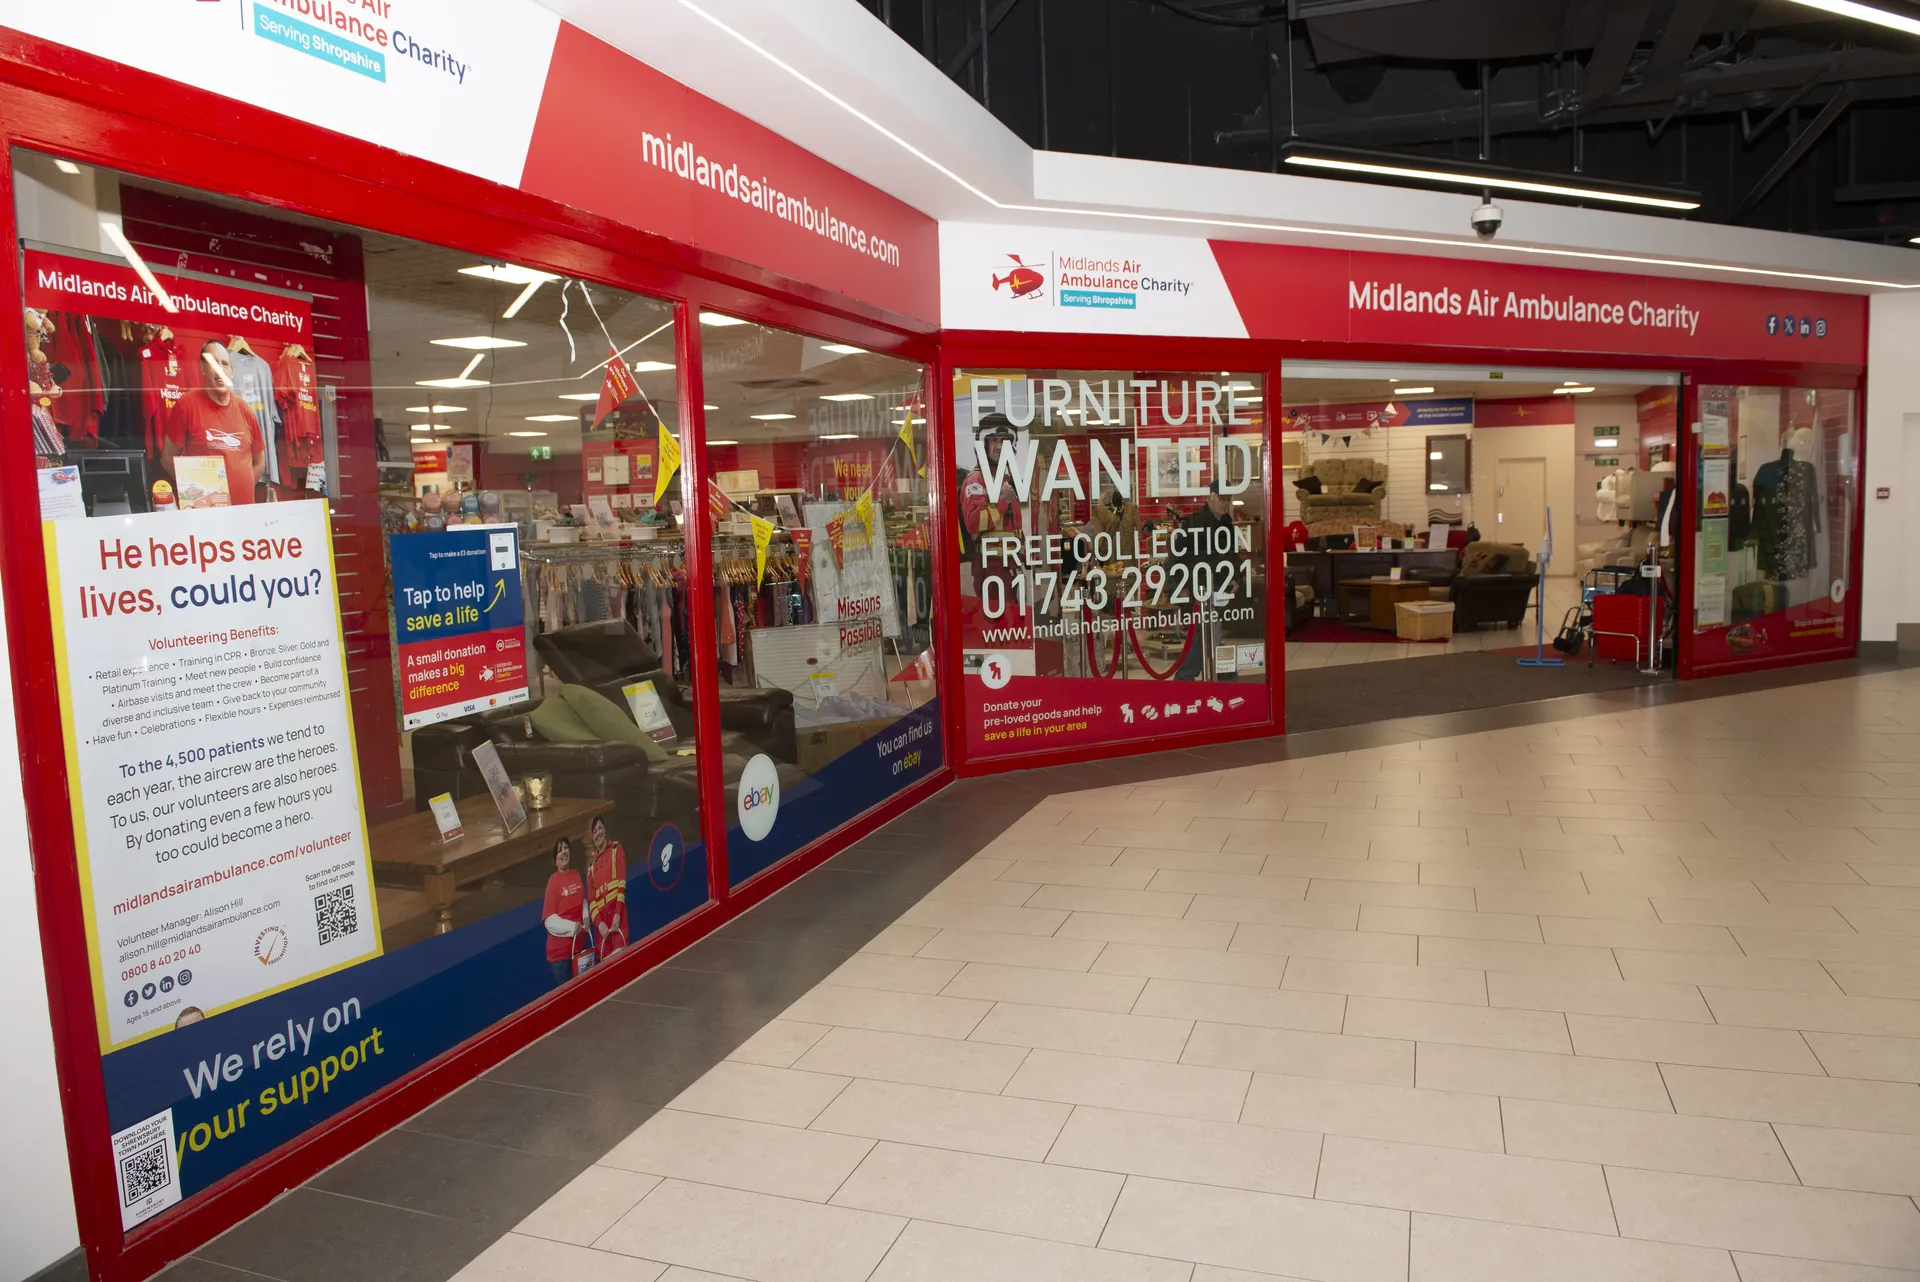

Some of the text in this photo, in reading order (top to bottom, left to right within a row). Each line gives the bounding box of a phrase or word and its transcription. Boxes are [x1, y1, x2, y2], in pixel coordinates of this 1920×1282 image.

[260, 14, 381, 72] Serving Shropshire
[274, 0, 466, 84] bulance Charity
[642, 131, 900, 268] midlandsairambulance.com
[1060, 256, 1141, 274] Midlands Air
[1060, 273, 1190, 296] Ambulance Charity
[38, 268, 304, 333] Midlands Air mbulance Charity
[1063, 294, 1134, 307] Serving Shropshire
[1349, 280, 1700, 336] Midlands Air Ambulance Charity
[970, 378, 1252, 427] FURNITURE
[833, 458, 872, 478] We need
[974, 437, 1252, 504] WANTED
[100, 535, 303, 572] He helps save
[982, 525, 1252, 569] FREE COLLECTION
[79, 568, 322, 618] lives, could you?
[404, 580, 485, 609] Tap to help
[982, 559, 1252, 618] 01743 292021
[406, 606, 479, 632] save a life
[838, 594, 881, 620] Missions
[148, 625, 278, 650] Volunteering Benefits:
[839, 621, 882, 649] Possible
[982, 608, 1254, 644] www.midlandsairambulance.com
[95, 667, 121, 680] Retail
[122, 662, 169, 676] expeence
[178, 656, 213, 667] Training
[223, 650, 241, 661] CPR
[249, 647, 277, 657] Bronze,
[278, 644, 299, 653] Silver,
[299, 640, 316, 650] Gold
[316, 638, 329, 647] and
[407, 654, 415, 668] A
[416, 650, 443, 666] small
[444, 644, 486, 661] donation
[408, 662, 465, 684] makes a big
[409, 680, 460, 700] difference
[983, 698, 1042, 713] Donate your
[92, 689, 340, 744] Have fun Celebrations Flexible hours Expenses reimbursed
[984, 704, 1102, 729] pre-loved goods and help
[984, 721, 1088, 742] save a life in your area
[118, 724, 324, 778] To the 4,500 patients we tend to
[876, 721, 933, 758] You can find us
[892, 750, 922, 775] on ebay
[744, 783, 774, 811] ebay
[113, 831, 351, 915] midlandsairambulance.com/volunteer
[305, 860, 355, 881] Scan the QR code
[116, 897, 243, 948] Volunteer Manager: Alison Hill
[118, 900, 280, 962] alison.hill@midlandsairambulance.com
[254, 926, 280, 956] INVESTING
[121, 943, 201, 981] 0800 8 40 20 40
[126, 998, 181, 1024] Ages 16 and above
[182, 997, 362, 1100] We rely on
[176, 1026, 384, 1173] your support
[114, 1115, 167, 1146] DOWNLOAD YOUR
[118, 1129, 166, 1157] TOWN MAP HERE
[121, 1125, 161, 1149] SHREWSBURY
